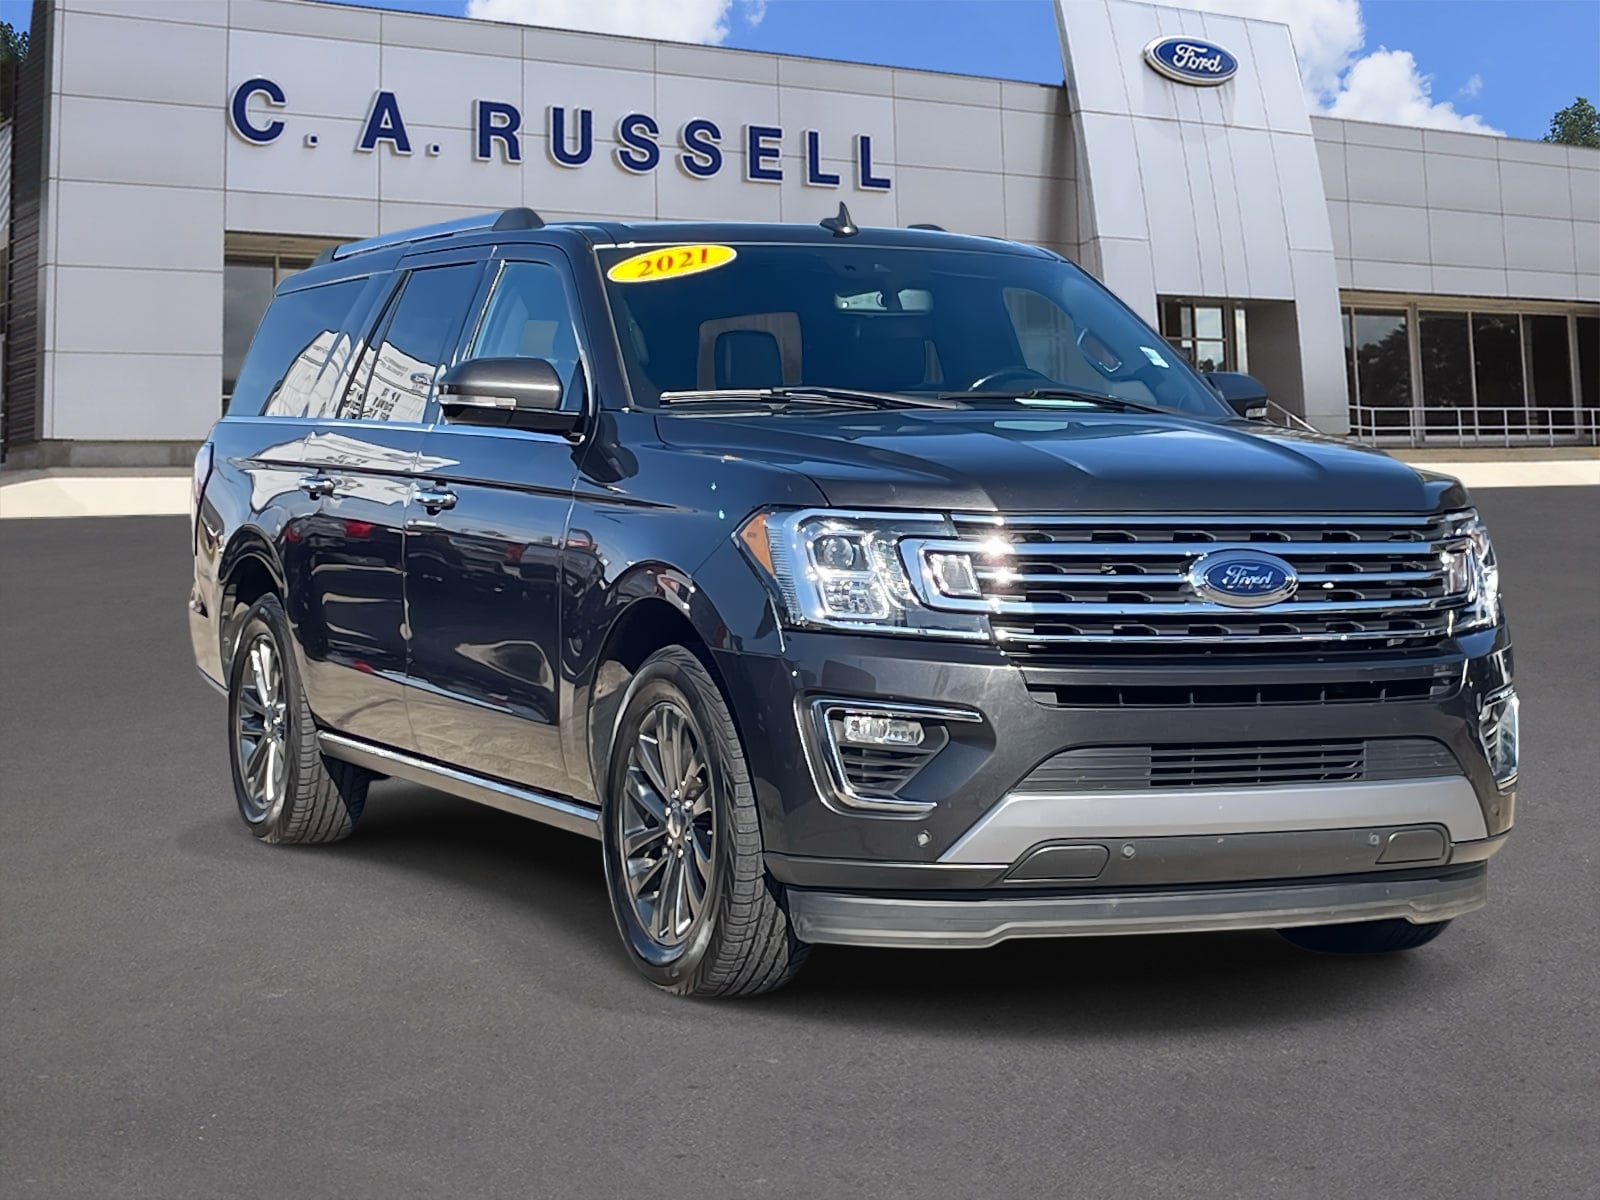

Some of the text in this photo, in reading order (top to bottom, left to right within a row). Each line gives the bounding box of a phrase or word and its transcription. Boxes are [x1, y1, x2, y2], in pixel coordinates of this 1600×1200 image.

[1172, 43, 1222, 73] Ford
[476, 99, 892, 190] RUSSELL
[638, 247, 708, 278] 2021
[1221, 563, 1274, 590] Ford
